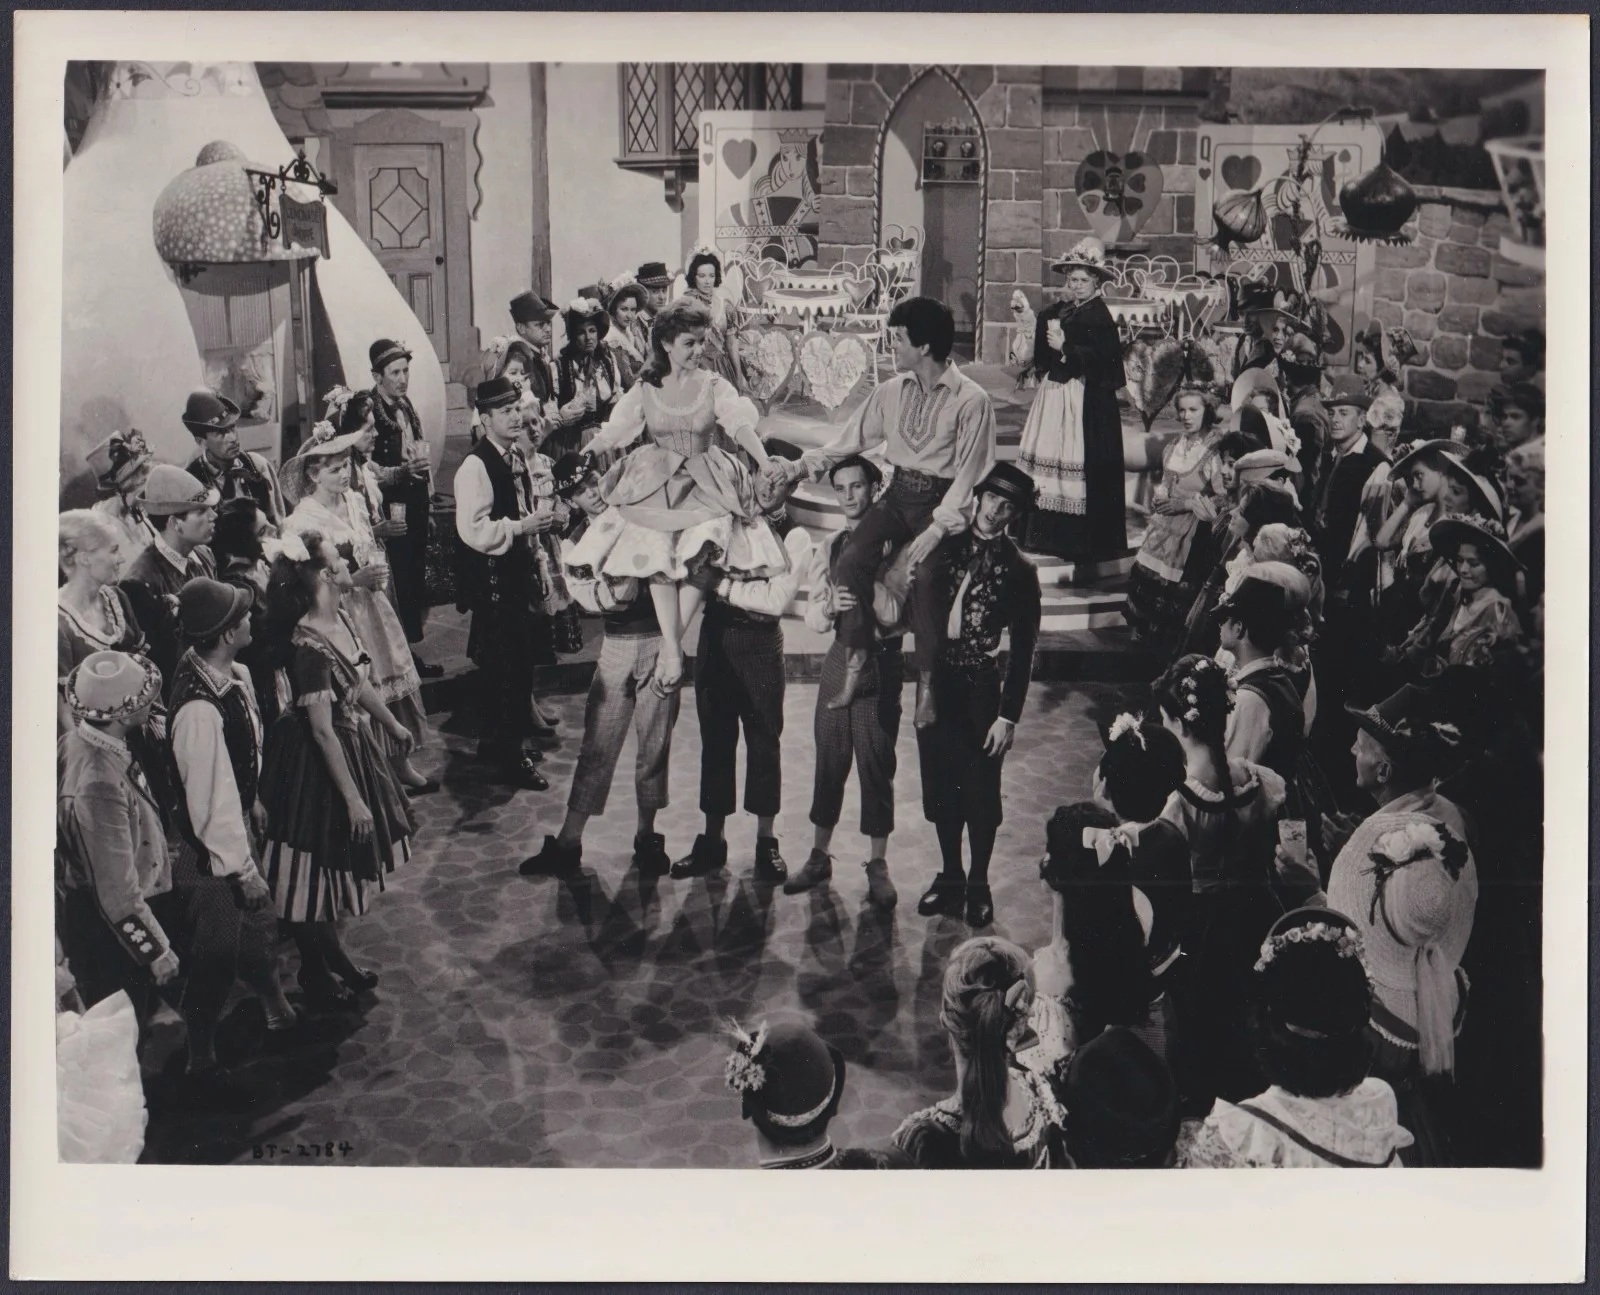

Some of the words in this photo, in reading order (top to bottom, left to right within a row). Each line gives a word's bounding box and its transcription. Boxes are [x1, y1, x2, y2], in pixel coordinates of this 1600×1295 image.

[703, 122, 713, 146] Q
[1200, 135, 1211, 162] Q
[252, 1141, 353, 1159] BT-2784
